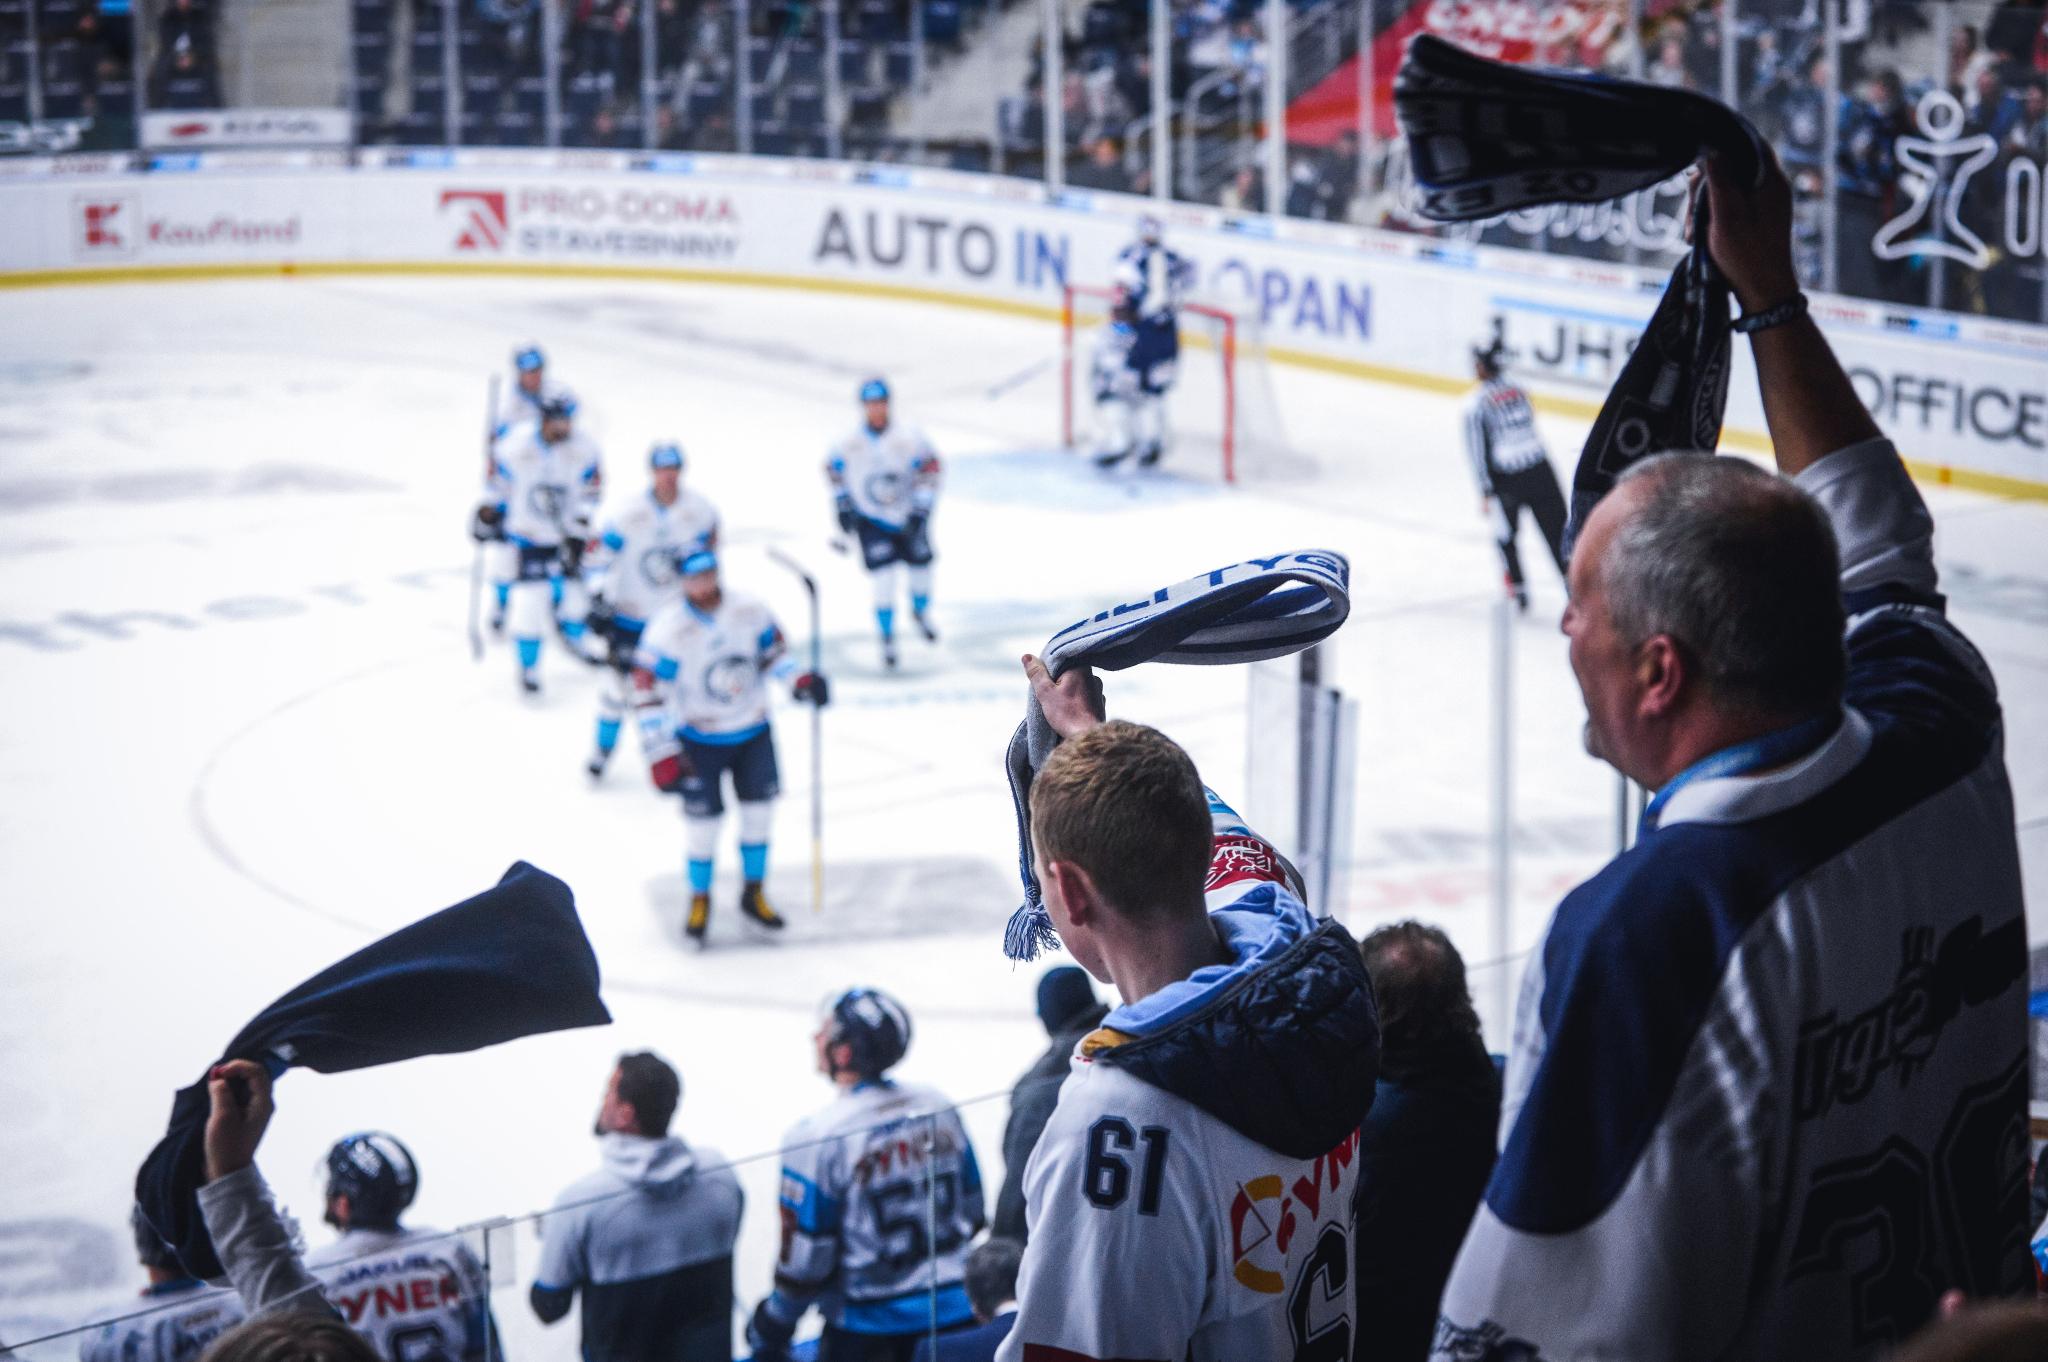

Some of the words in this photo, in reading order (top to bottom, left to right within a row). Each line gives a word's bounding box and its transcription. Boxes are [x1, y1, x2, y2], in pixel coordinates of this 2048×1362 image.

[518, 189, 737, 225] PRO-DOMA
[147, 215, 299, 245] Kaufland
[1848, 368, 2046, 448] OFFICE
[1193, 553, 1348, 592] TYG
[1083, 1115, 1170, 1217] 61
